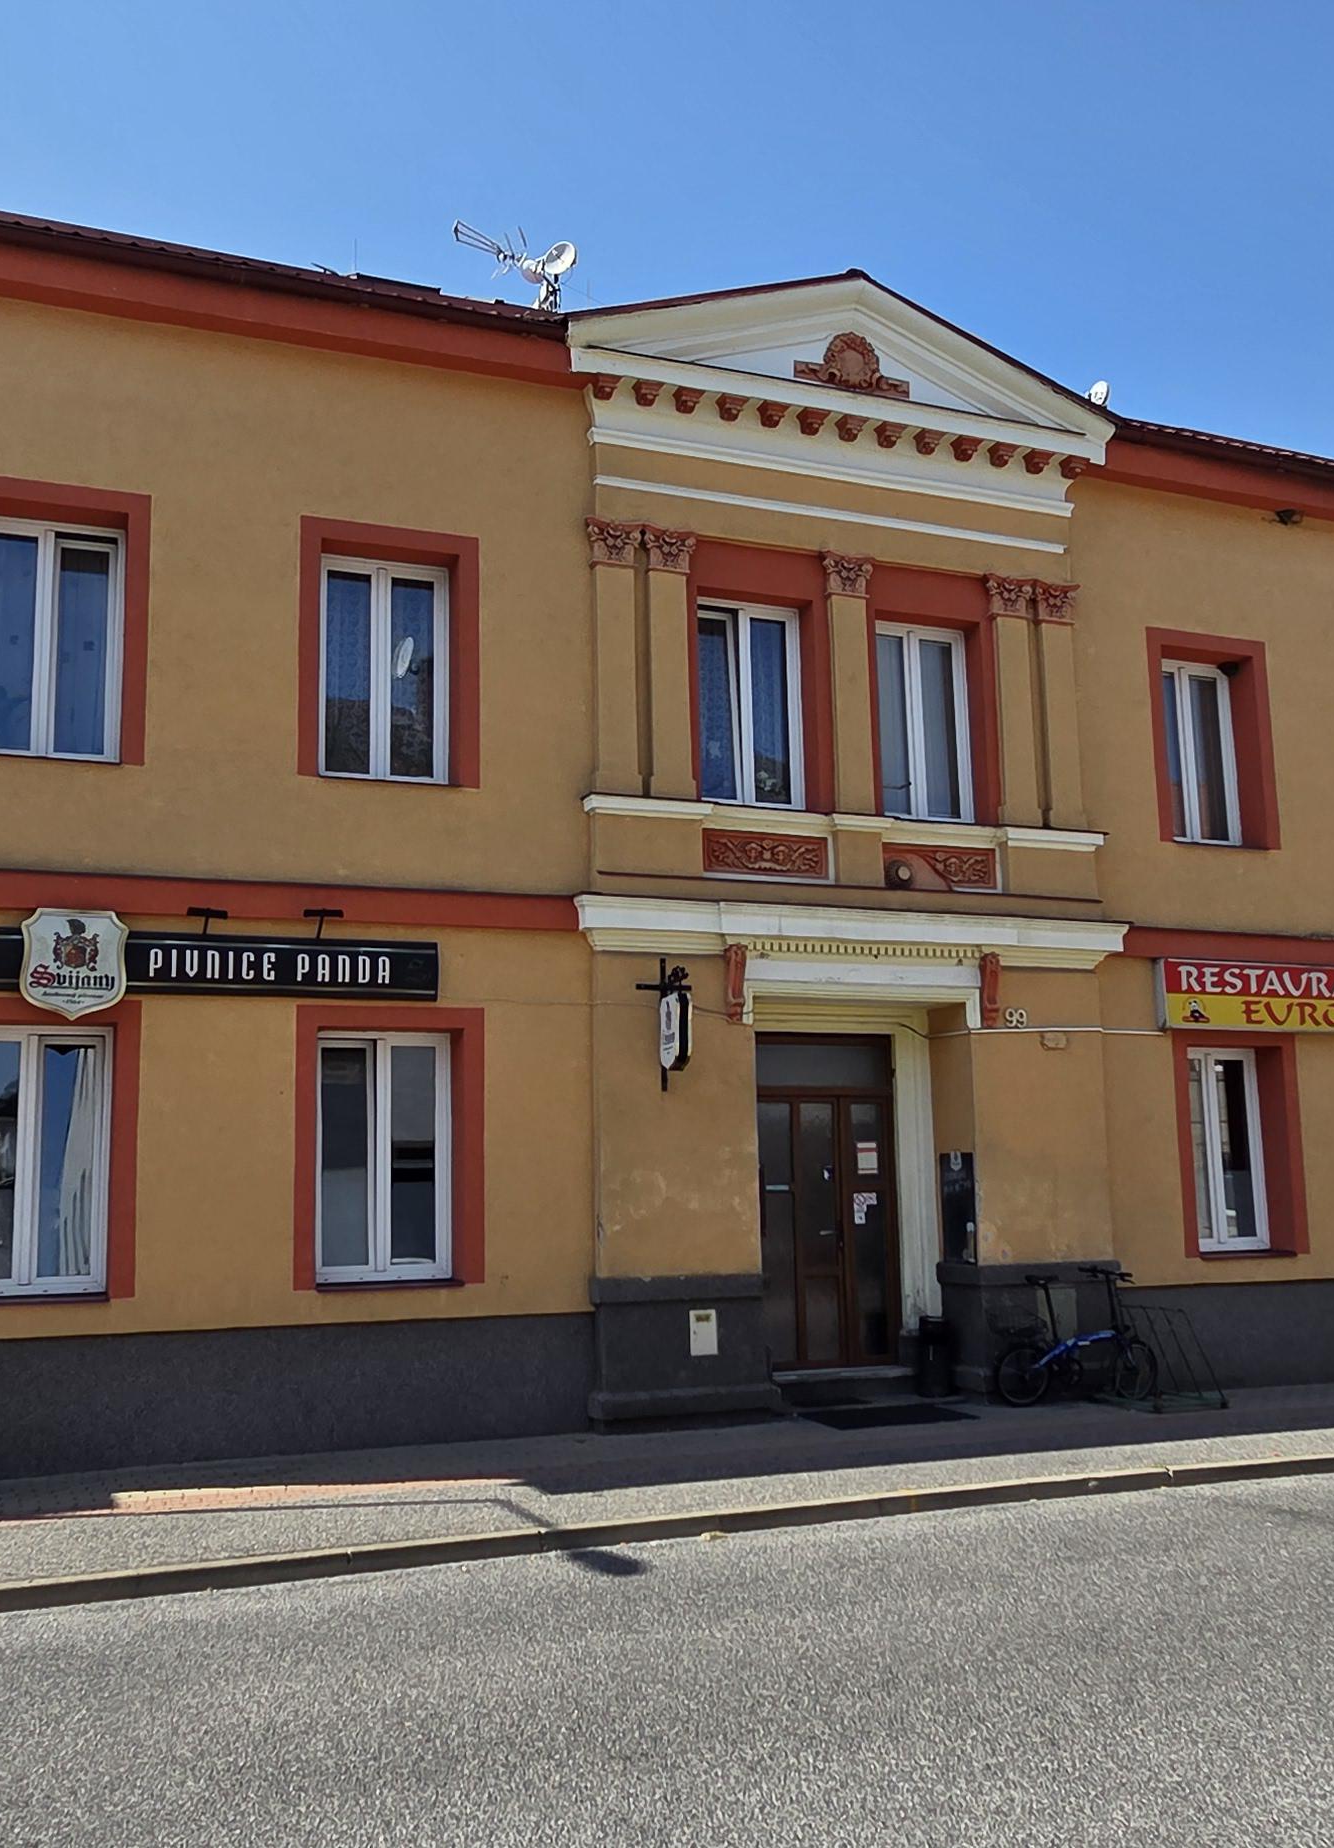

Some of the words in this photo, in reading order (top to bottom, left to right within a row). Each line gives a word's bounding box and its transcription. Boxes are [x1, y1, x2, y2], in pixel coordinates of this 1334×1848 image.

[29, 963, 116, 992] Svijany
[149, 947, 276, 981] PIVNICE
[296, 953, 391, 984] PANDA
[1005, 1008, 1027, 1028] 99
